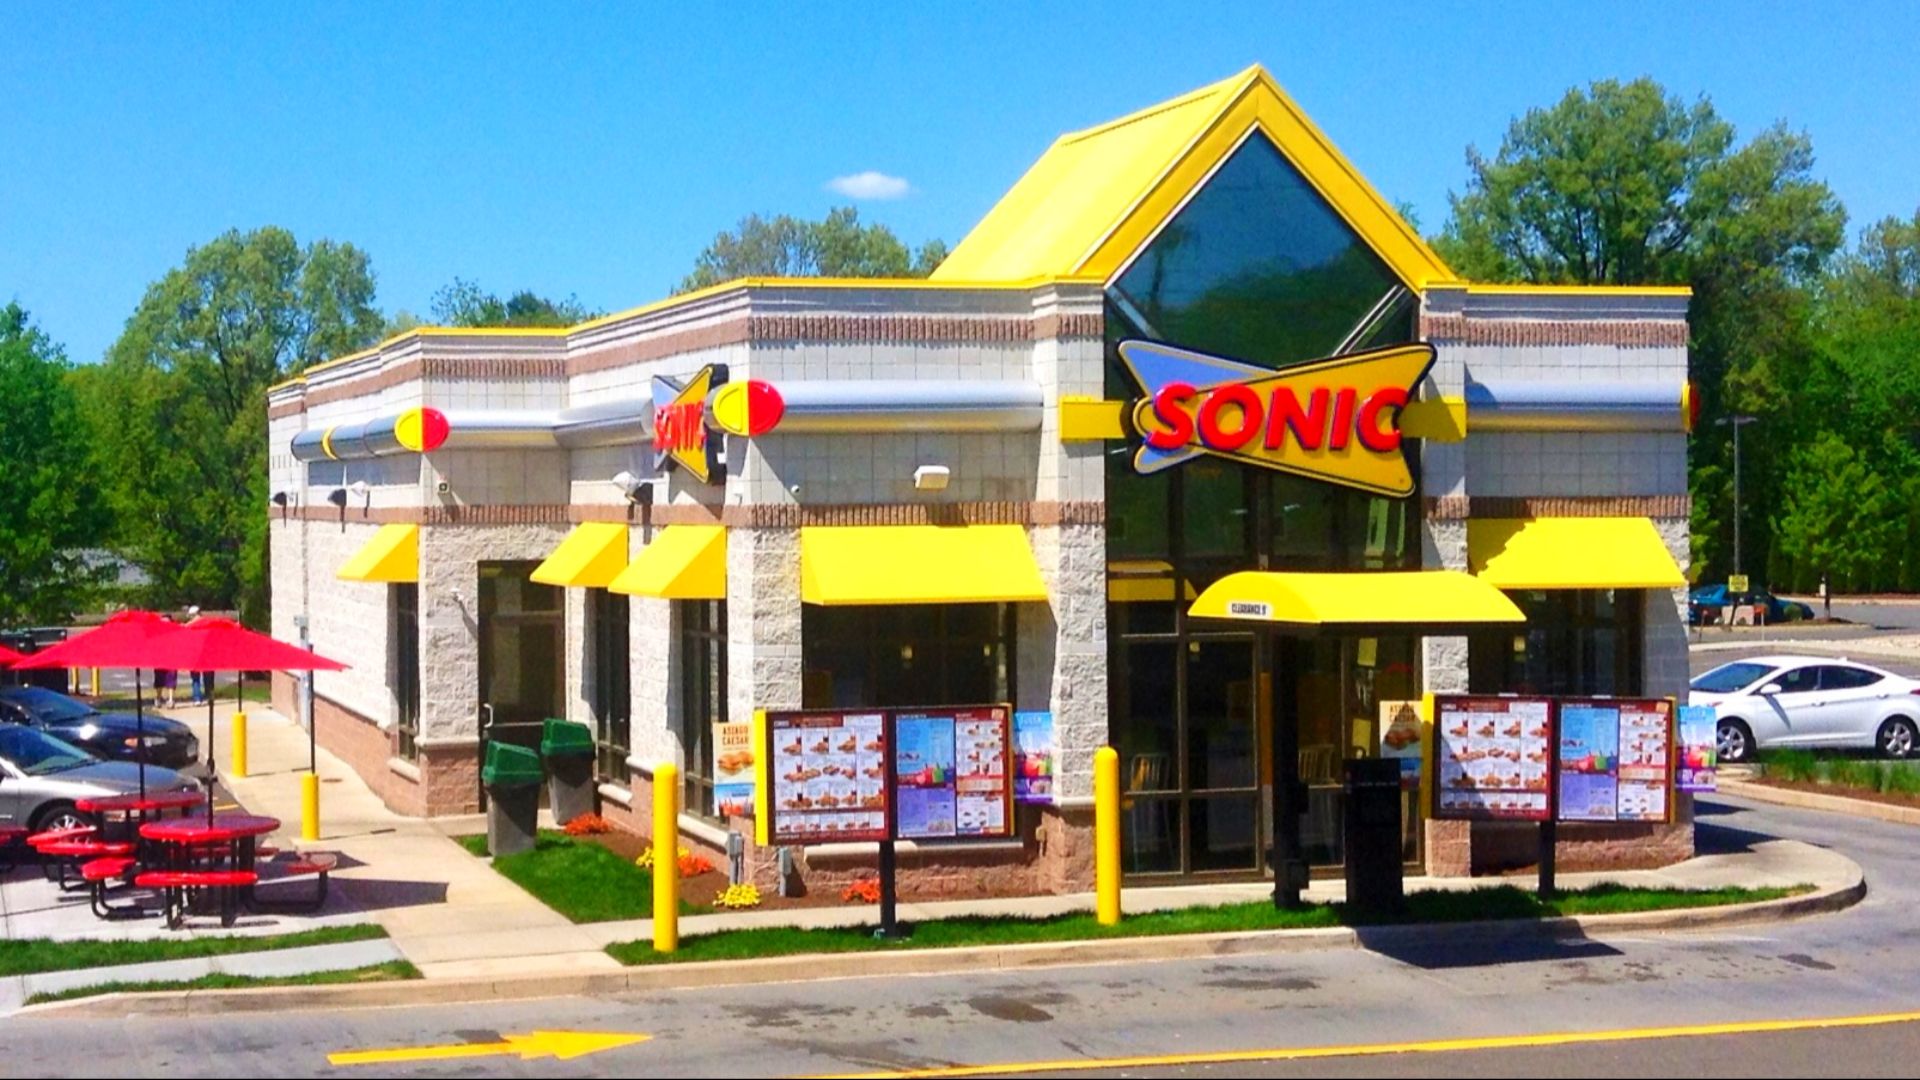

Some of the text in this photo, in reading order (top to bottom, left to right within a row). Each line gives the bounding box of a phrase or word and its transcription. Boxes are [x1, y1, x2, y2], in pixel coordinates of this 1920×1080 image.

[1144, 382, 1408, 451] SONIC
[723, 726, 749, 734] ASIAGO
[722, 736, 749, 745] CAESAR
